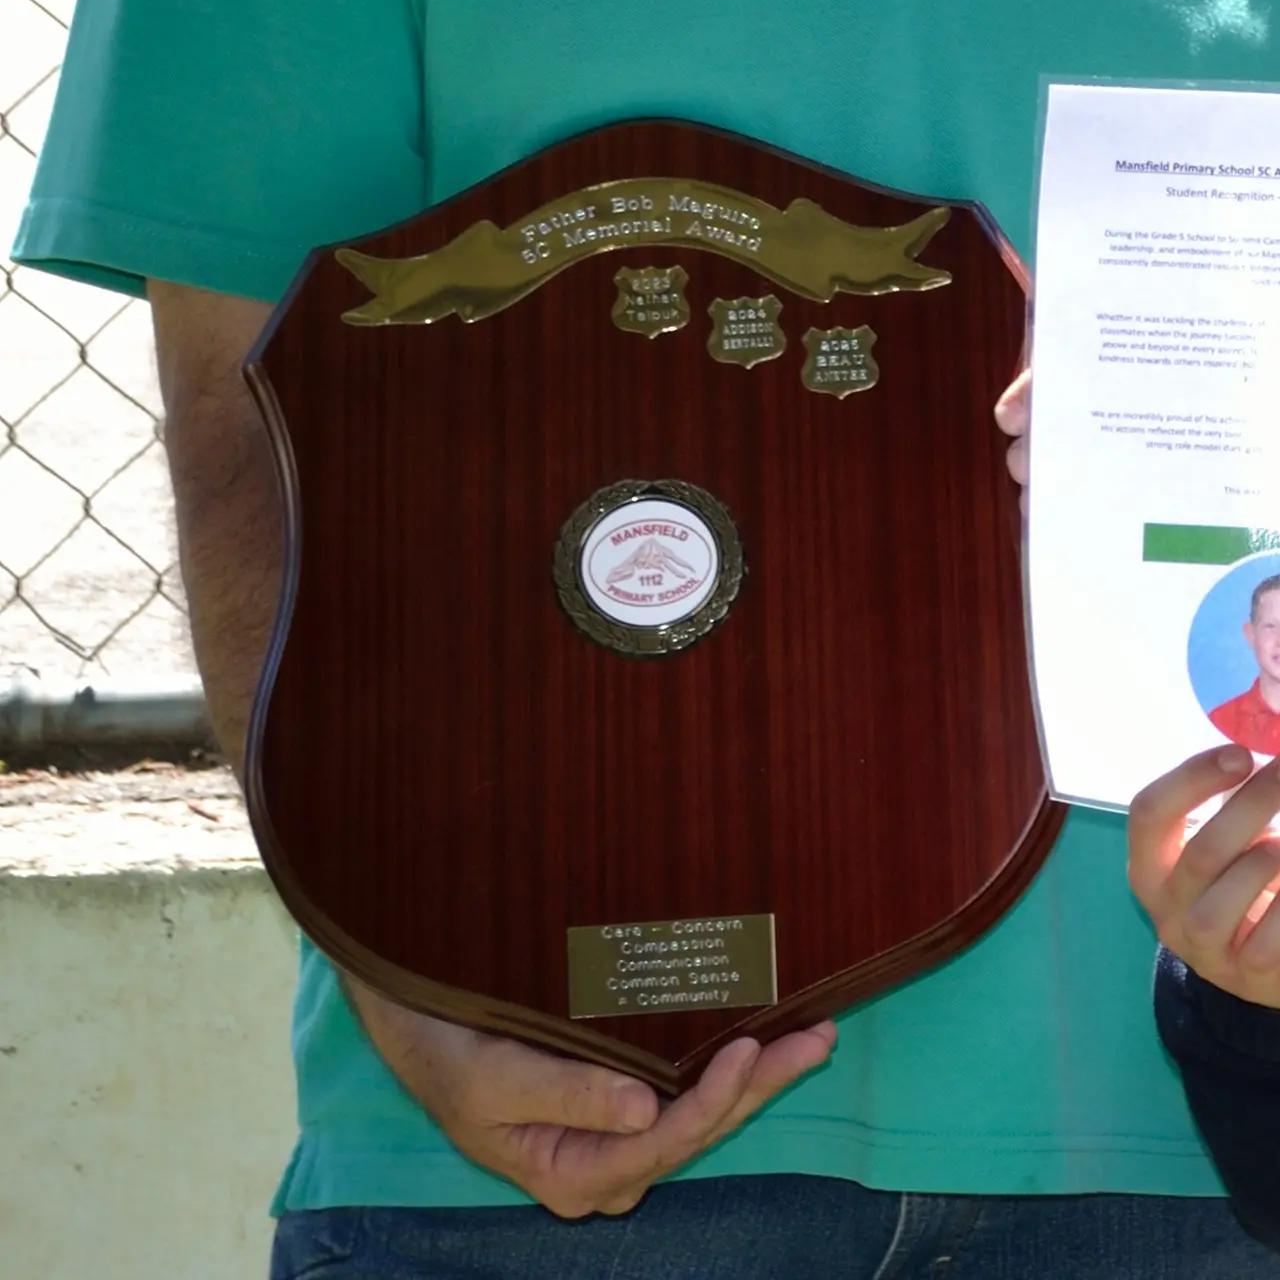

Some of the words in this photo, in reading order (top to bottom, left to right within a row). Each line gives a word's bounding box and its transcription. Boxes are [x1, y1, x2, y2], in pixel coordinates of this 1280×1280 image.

[1115, 160, 1170, 173] Mansfield
[1173, 162, 1215, 176] Primary
[1218, 164, 1255, 176] School
[1166, 187, 1208, 199] Student
[1211, 188, 1275, 202] Recognition
[520, 204, 596, 243] Father
[610, 195, 654, 214] Bob
[667, 194, 762, 230] Maguire
[562, 216, 672, 248] Memorial
[685, 220, 763, 252] Award
[727, 308, 767, 321] 2024
[722, 322, 774, 336] ADDISON
[816, 353, 865, 367] BEAU
[609, 523, 690, 547] MANSFIELD
[605, 584, 655, 604] PRIMARY
[658, 576, 700, 602] SCHOOL
[638, 573, 665, 588] 1112
[600, 924, 643, 940] Care
[671, 918, 744, 936] Concern
[620, 936, 725, 956] Compassion
[616, 954, 730, 973] Communication
[606, 974, 680, 991] Common
[688, 970, 741, 986] Sense
[636, 988, 730, 1007] Community
